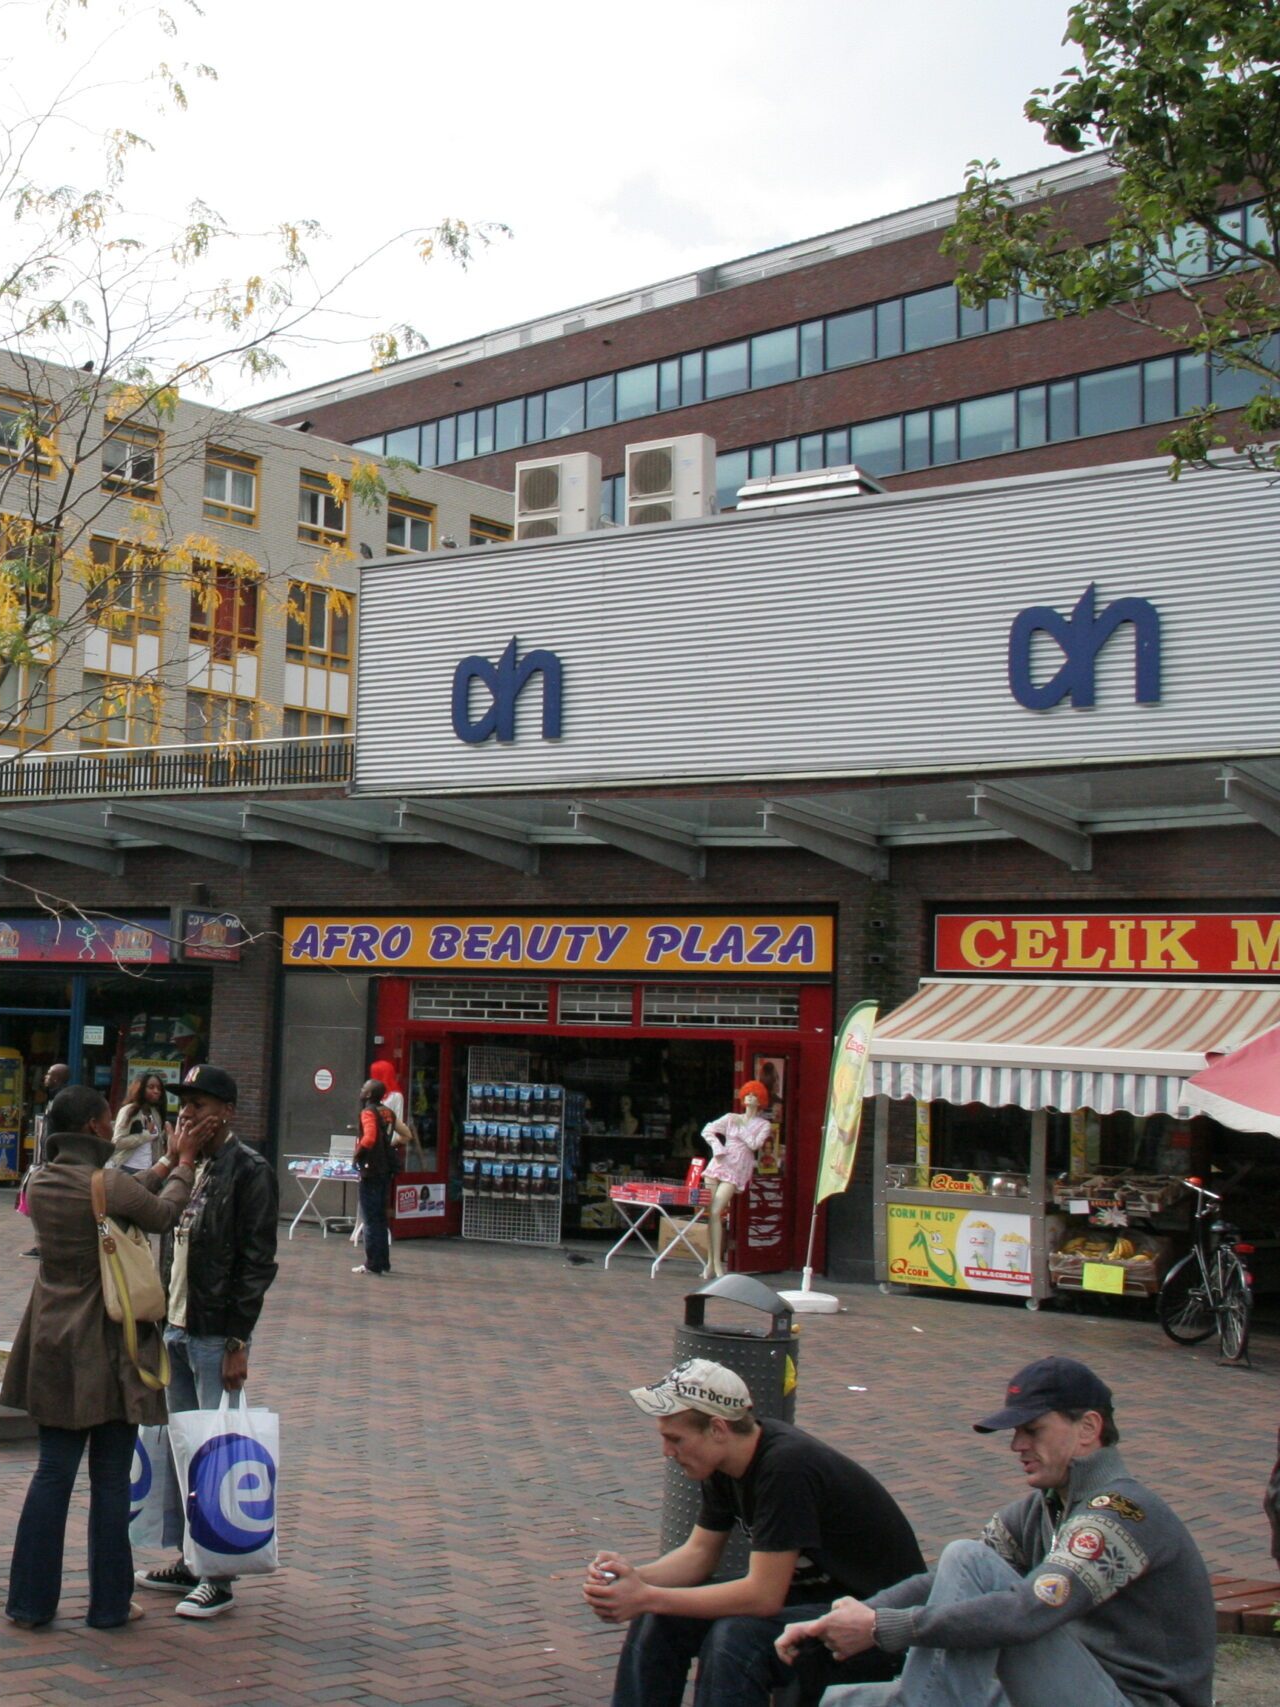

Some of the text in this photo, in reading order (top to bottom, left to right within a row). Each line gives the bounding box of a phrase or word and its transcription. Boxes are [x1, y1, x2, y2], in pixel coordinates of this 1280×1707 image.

[291, 923, 815, 966] AFRO BEAUTY PLAZA
[399, 1190, 415, 1201] 200
[889, 1207, 956, 1222] CORN IN CUP
[673, 1382, 745, 1408] Hardcore
